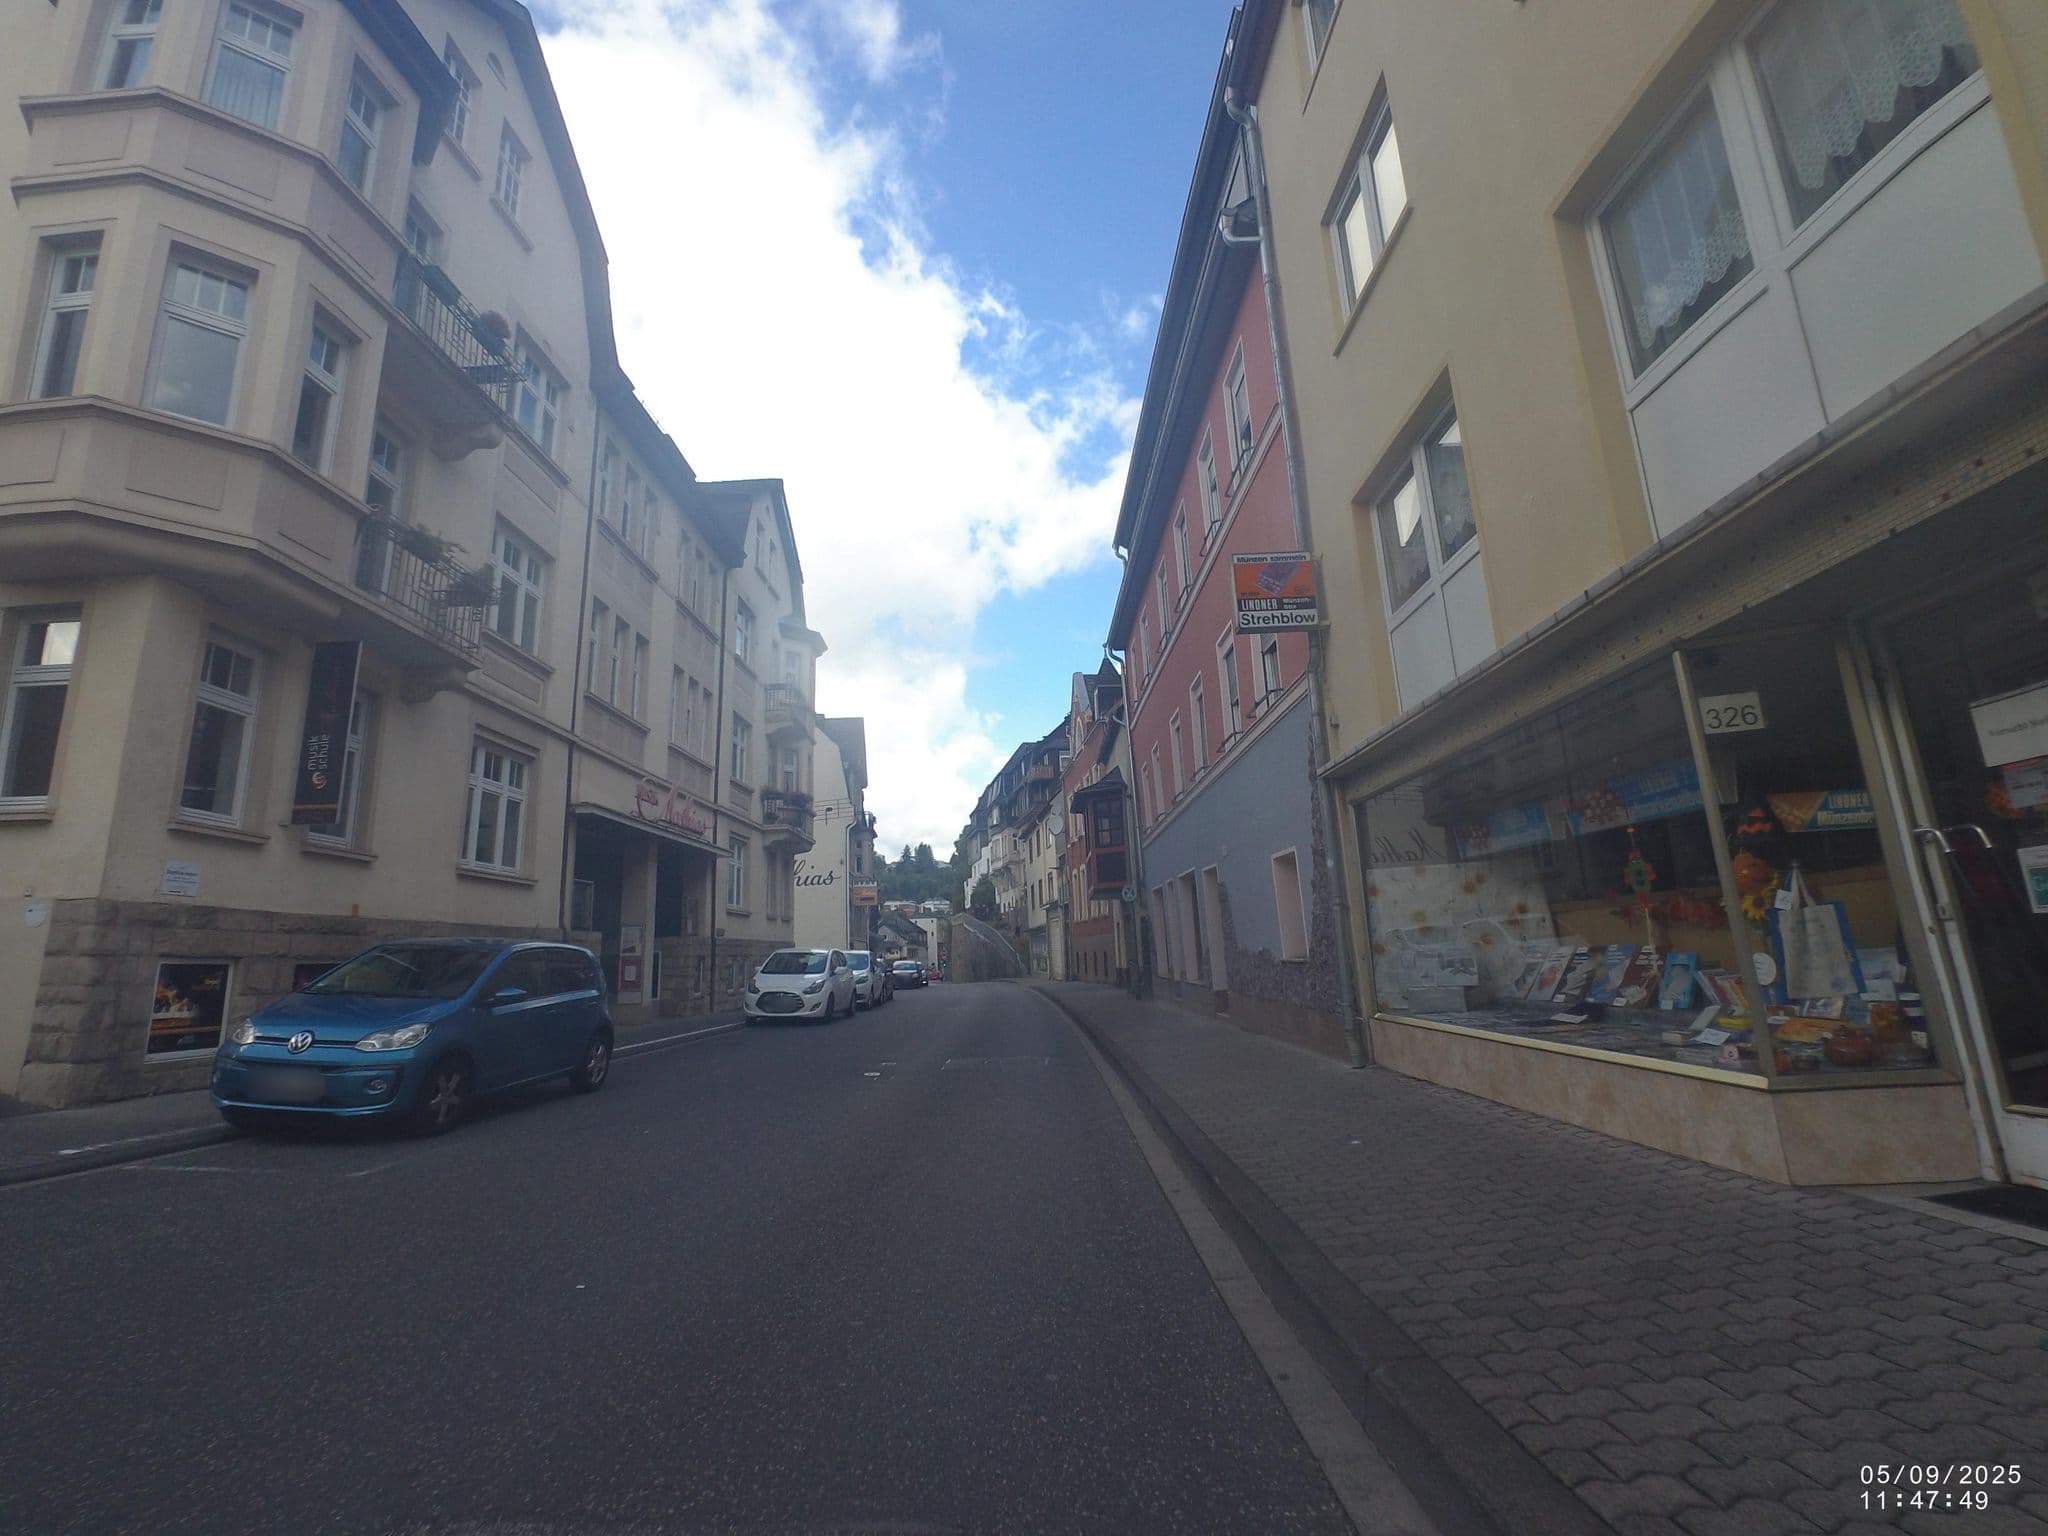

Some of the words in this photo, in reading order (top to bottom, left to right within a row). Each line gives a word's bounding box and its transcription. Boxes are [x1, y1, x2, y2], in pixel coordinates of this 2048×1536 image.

[1269, 554, 1307, 562] sammeln
[1241, 598, 1278, 611] LINDNER
[1240, 612, 1316, 626] Strehblow
[1706, 704, 1759, 729] 326
[307, 735, 319, 770] musik
[318, 734, 330, 770] schule
[794, 859, 842, 887] hias
